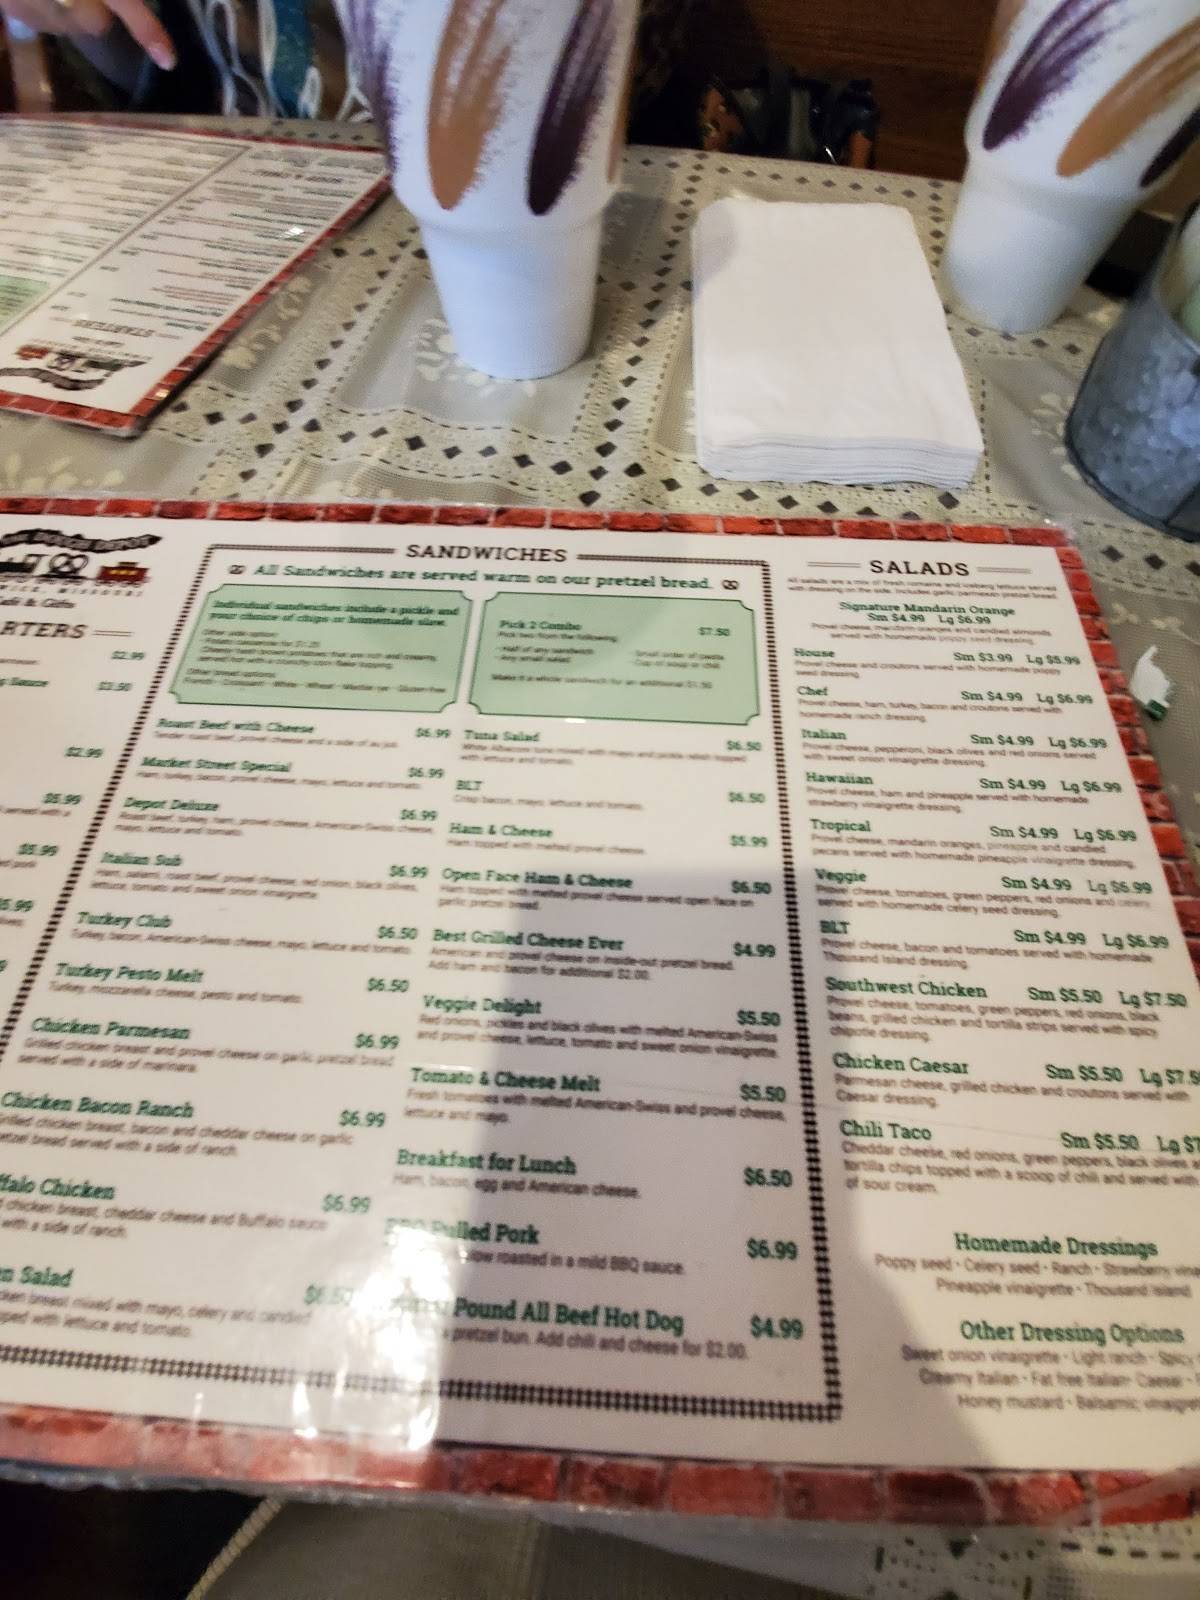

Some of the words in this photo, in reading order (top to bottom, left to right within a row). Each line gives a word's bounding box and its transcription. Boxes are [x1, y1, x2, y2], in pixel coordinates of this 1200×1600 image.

[406, 544, 567, 562] SANDWICHES
[255, 564, 278, 576] All
[284, 565, 384, 579] Sandwiches
[390, 570, 420, 579] are
[424, 570, 477, 581] served
[484, 573, 530, 583] warm
[538, 575, 558, 584] on
[564, 575, 591, 585] our
[596, 575, 655, 589] pretzel
[661, 576, 712, 589] bread.
[870, 560, 970, 576] SALADS
[839, 601, 900, 613] Signature
[904, 604, 965, 614] Mandarin
[969, 606, 1015, 617] Orange
[868, 613, 888, 622] Sm
[891, 614, 925, 623] $4.99
[939, 614, 954, 625] Lg
[958, 615, 991, 624] $6.99
[530, 620, 537, 629] 2
[540, 621, 582, 631] Combo
[698, 627, 730, 637] $7.50
[794, 648, 835, 658] House
[954, 652, 975, 662] Sm
[980, 652, 1012, 663] $3.99
[1026, 654, 1043, 665] Lg
[798, 685, 828, 696] Chef
[961, 690, 983, 701] Sm
[987, 691, 1023, 702] $4.99
[1036, 693, 1053, 705] Lg
[1057, 694, 1093, 704] $6.99
[200, 720, 229, 730] Beef
[234, 722, 261, 731] with
[266, 722, 314, 733] Cheese
[416, 727, 451, 739] $6.99
[464, 730, 498, 740] Tuna
[503, 731, 540, 742] Salad
[727, 740, 762, 751] $6.50
[802, 729, 846, 740] Italian
[971, 735, 993, 745] Sm
[997, 735, 1033, 746] $4.99
[1049, 737, 1066, 749] Lg
[1070, 738, 1107, 749] $6.99
[142, 757, 192, 767] Market
[240, 760, 291, 773] Special
[408, 767, 445, 779] $6.99
[456, 780, 483, 790] BLT
[729, 792, 765, 803] $6.50
[806, 772, 873, 784] Hawaiian
[979, 778, 1004, 789] Sm
[1008, 778, 1045, 790] $4.99
[1061, 780, 1079, 794] Lg
[1083, 781, 1121, 792] $6.99
[400, 809, 437, 821] $6.99
[450, 823, 483, 834] Ham
[488, 825, 496, 835] &
[502, 825, 553, 837] Cheese
[730, 835, 767, 847] $5.99
[810, 818, 871, 835] Tropical
[990, 826, 1014, 837] Sm
[1018, 826, 1058, 839] $4.99
[1074, 828, 1093, 842] Lg
[1097, 829, 1136, 841] $6.99
[154, 855, 182, 866] Sub
[390, 865, 429, 878] $6.99
[442, 867, 481, 882] Open
[487, 869, 520, 882] Face
[524, 871, 560, 885] Ham
[565, 874, 573, 885] &
[578, 874, 633, 888] Cheese
[731, 880, 771, 894] $6.50
[815, 868, 866, 883] Veggie
[1001, 877, 1027, 889] Sm
[1032, 877, 1071, 891] $4.99
[1088, 879, 1109, 893] Lg
[1112, 880, 1152, 893] $6.99
[78, 911, 133, 929] Turkey
[136, 914, 173, 928] Club
[378, 926, 418, 939] $6.50
[433, 929, 467, 942] Best
[472, 930, 522, 946] Grilled
[528, 933, 583, 948] Cheese
[588, 936, 624, 950] Ever
[733, 942, 776, 958] $4.99
[1014, 930, 1040, 943] Sm
[1045, 931, 1086, 945] $4.99
[1103, 933, 1123, 949] Lg
[1128, 934, 1168, 948] $6.99
[57, 962, 113, 982] Turkey
[116, 965, 162, 981] Pesto
[166, 968, 204, 983] Melt
[367, 977, 409, 993] $6.50
[825, 977, 914, 994] Southwest
[919, 981, 987, 998] Chicken
[1028, 987, 1055, 1001] Sm
[1060, 989, 1103, 1003] $5.50
[1118, 991, 1141, 1008] Lg
[1145, 992, 1187, 1006] $7.50
[424, 995, 477, 1013] Veggie
[484, 998, 542, 1016] Delight
[738, 1009, 781, 1026] $5.50
[31, 1017, 100, 1035] Chicken
[356, 1033, 400, 1049] $6.99
[833, 1053, 905, 1071] Chicken
[911, 1058, 969, 1074] Caesar
[1046, 1065, 1074, 1079] Sm
[1079, 1066, 1123, 1082] $5.50
[1140, 1068, 1163, 1086] Lg
[411, 1067, 474, 1084] Tomato
[479, 1071, 489, 1086] &
[495, 1072, 556, 1089] Cheese
[561, 1075, 600, 1091] Melt
[740, 1083, 786, 1102] $5.50
[3, 1092, 73, 1112] Chicken
[77, 1096, 133, 1114] Bacon
[136, 1100, 194, 1118] Ranch
[339, 1109, 385, 1127] $6.99
[840, 1119, 883, 1137] Chili
[888, 1123, 932, 1140] Taco
[1060, 1132, 1090, 1148] Sm
[1096, 1133, 1139, 1150] $5.50
[1157, 1136, 1180, 1154] Lg
[397, 1149, 483, 1170] Breakfast
[489, 1152, 514, 1171] for
[519, 1154, 577, 1175] Lunch
[744, 1167, 792, 1187] $6.50
[39, 1178, 115, 1199] Chicken
[496, 1223, 539, 1244] Pork
[747, 1238, 798, 1259] $6.99
[955, 1232, 1062, 1254] Homemade
[1067, 1237, 1158, 1260] Dressings
[20, 1265, 74, 1287] Salad
[456, 1298, 517, 1321] Pound
[522, 1301, 549, 1322] All
[555, 1303, 599, 1326] Beef
[605, 1306, 639, 1328] Hot
[645, 1309, 684, 1336] Dog
[751, 1314, 803, 1338] $4.99
[536, 1330, 564, 1346] Add
[600, 1333, 625, 1351] and
[629, 1336, 679, 1354] cheese
[960, 1320, 1015, 1341] Other
[1020, 1322, 1106, 1346] Dressing
[1110, 1324, 1184, 1347] Options
